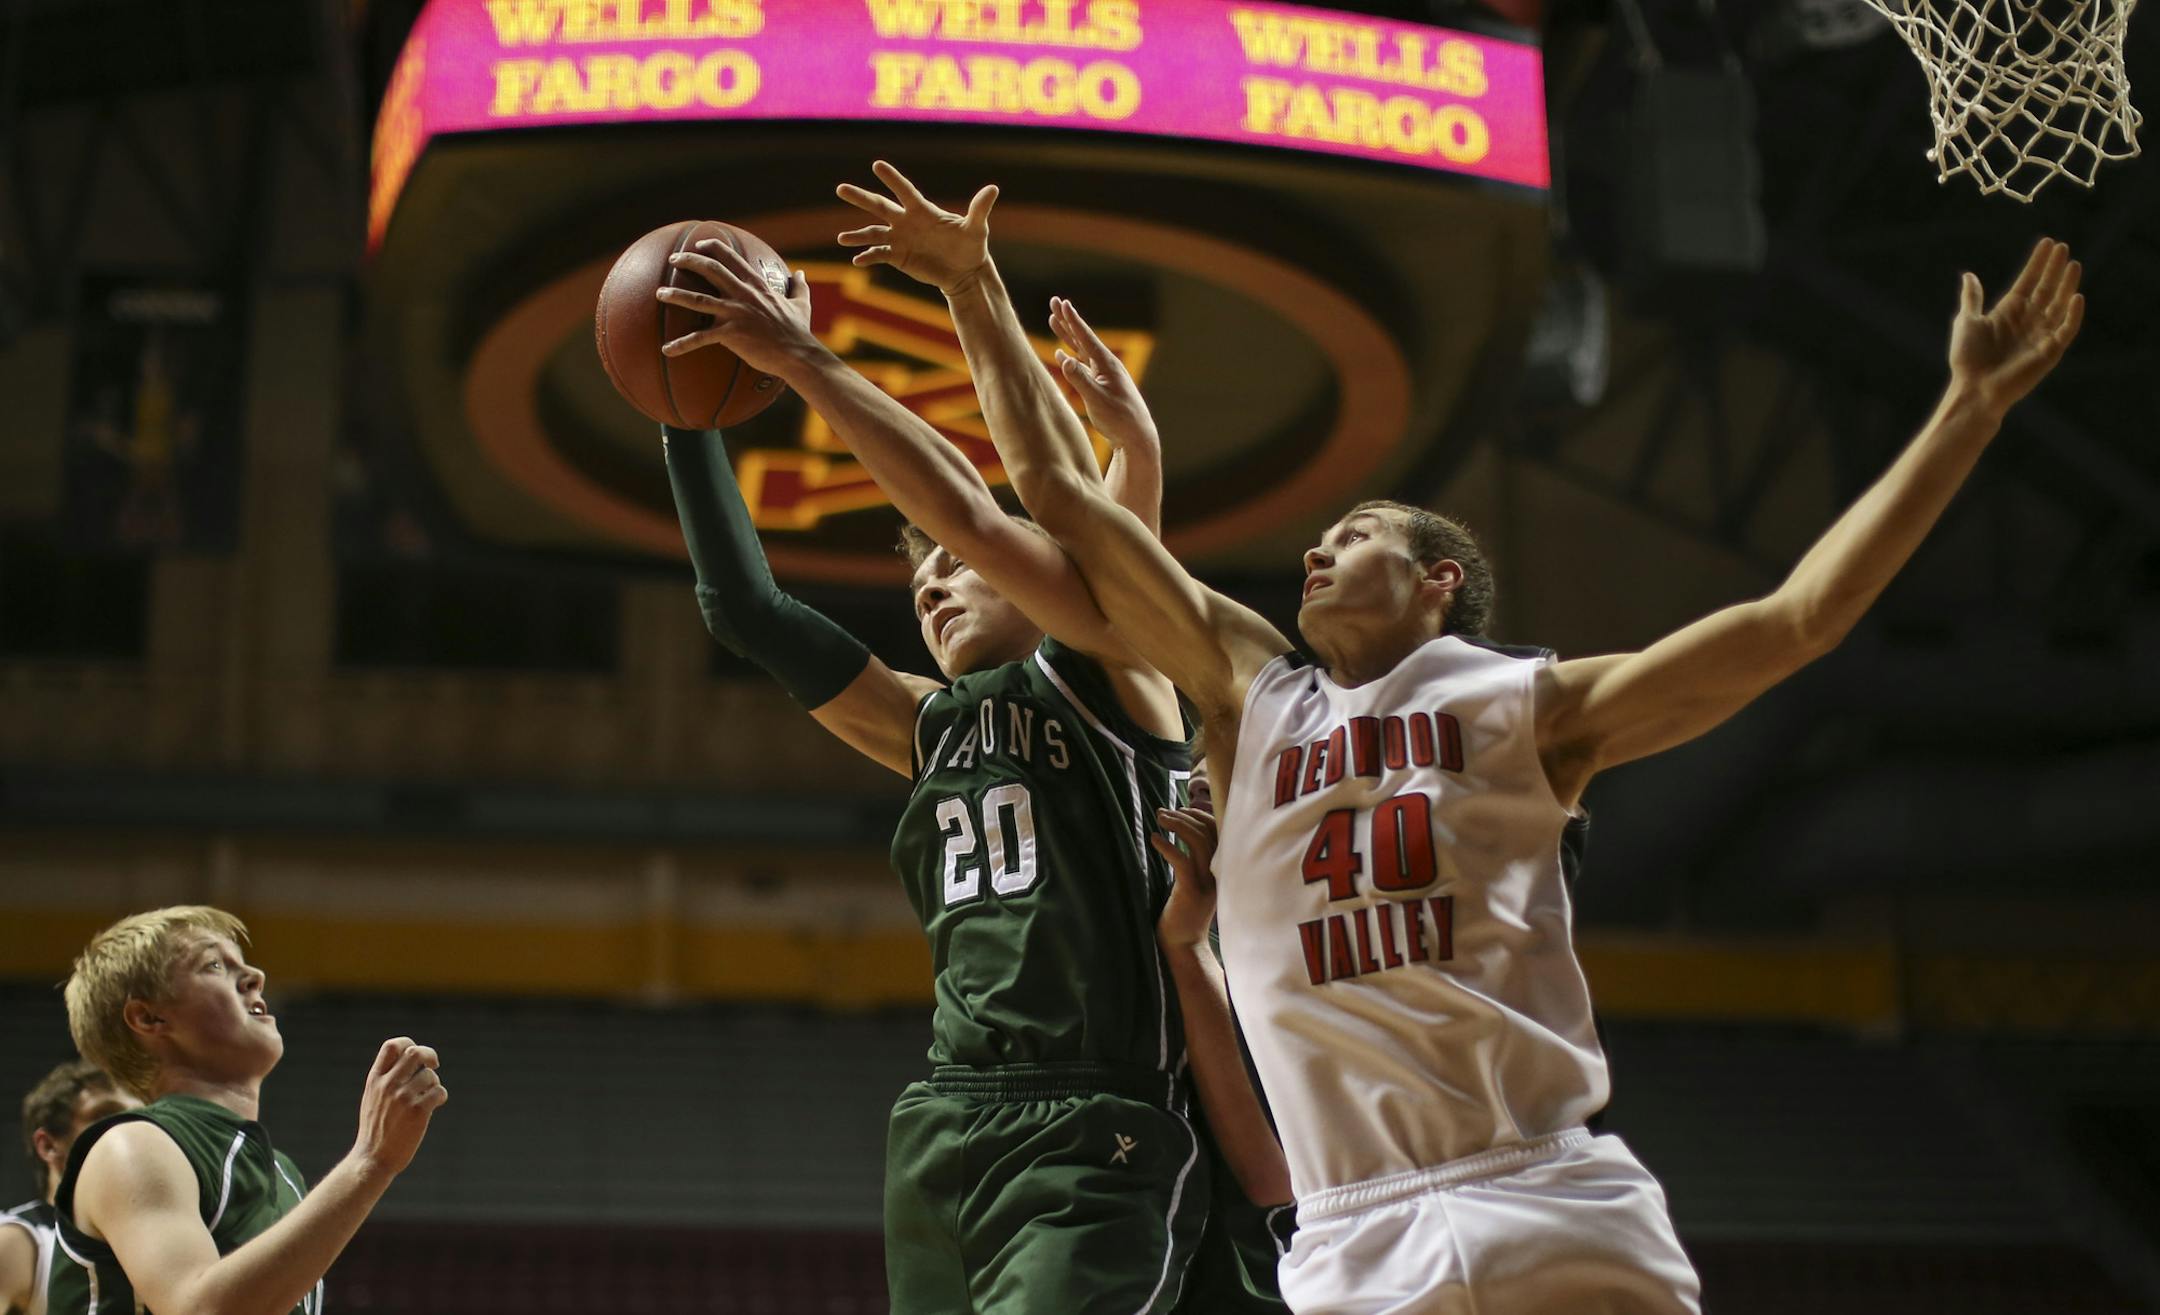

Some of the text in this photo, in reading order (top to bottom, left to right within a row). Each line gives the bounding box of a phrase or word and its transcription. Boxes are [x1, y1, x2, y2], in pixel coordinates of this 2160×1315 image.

[485, 0, 764, 47] WELLS
[870, 0, 1144, 51] WELLS
[1229, 9, 1488, 98] WELLS
[489, 48, 762, 117] FARGO
[868, 51, 1143, 121] FARGO
[1241, 74, 1489, 164] FARGO
[1274, 712, 1464, 809] REDWOOD
[936, 783, 1037, 905] 20
[1302, 792, 1438, 902] 40
[1297, 896, 1453, 985] VALLEY
